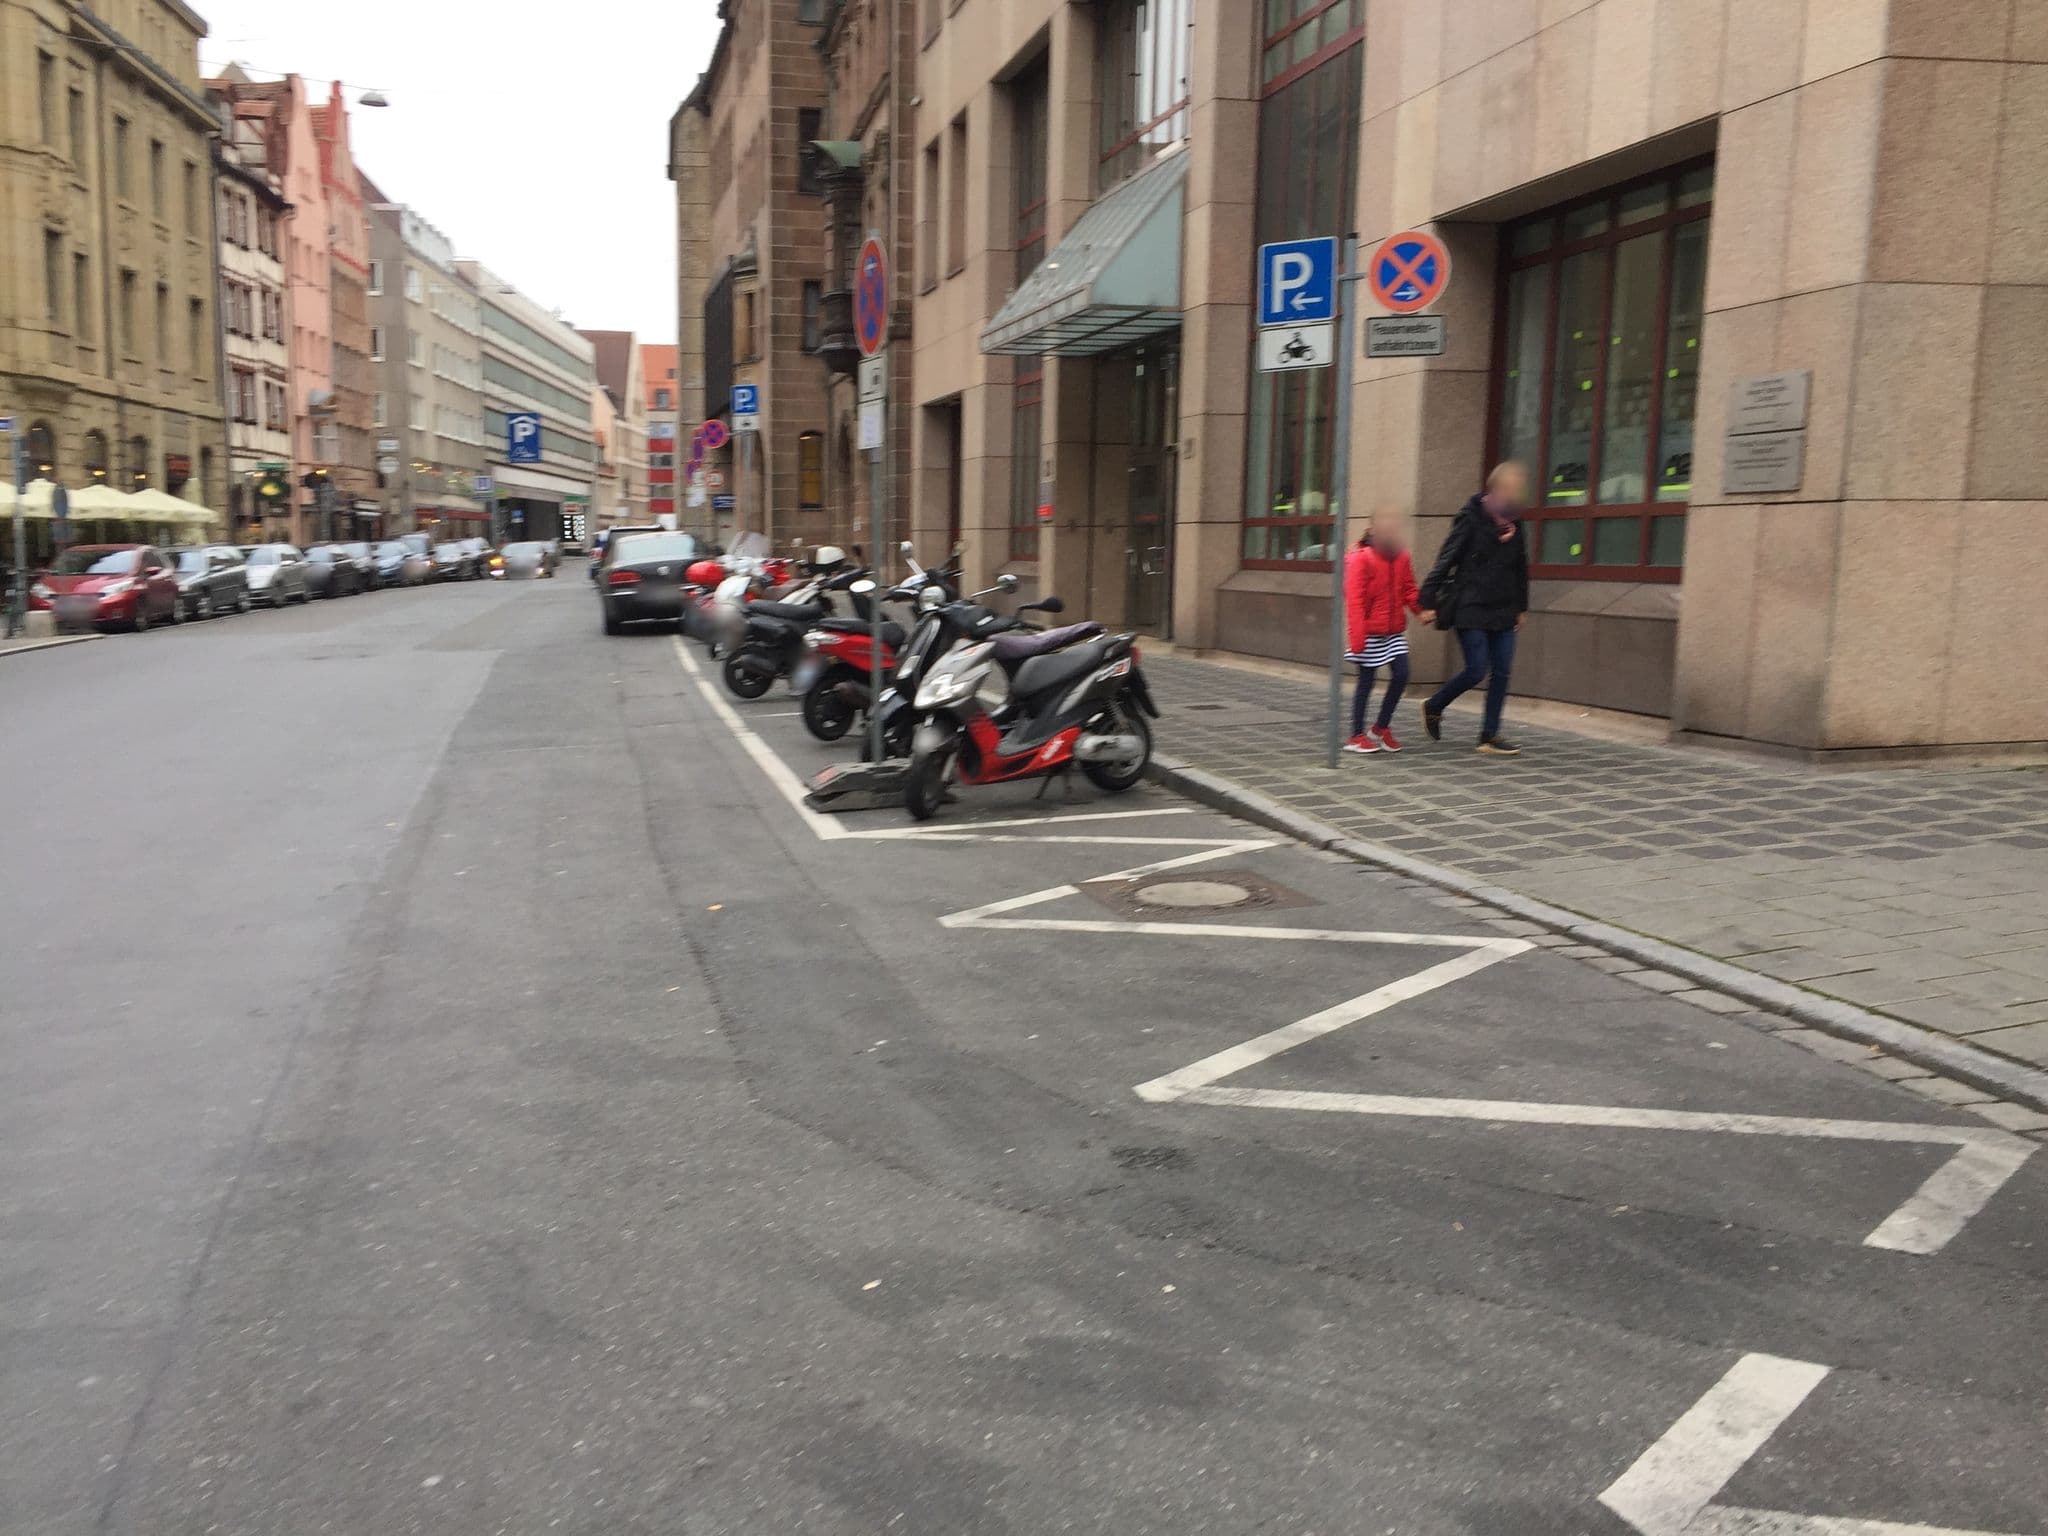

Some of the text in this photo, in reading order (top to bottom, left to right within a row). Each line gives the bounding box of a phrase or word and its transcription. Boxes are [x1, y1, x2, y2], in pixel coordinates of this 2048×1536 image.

[1271, 252, 1314, 314] P
[734, 389, 753, 410] P
[513, 422, 536, 443] P
